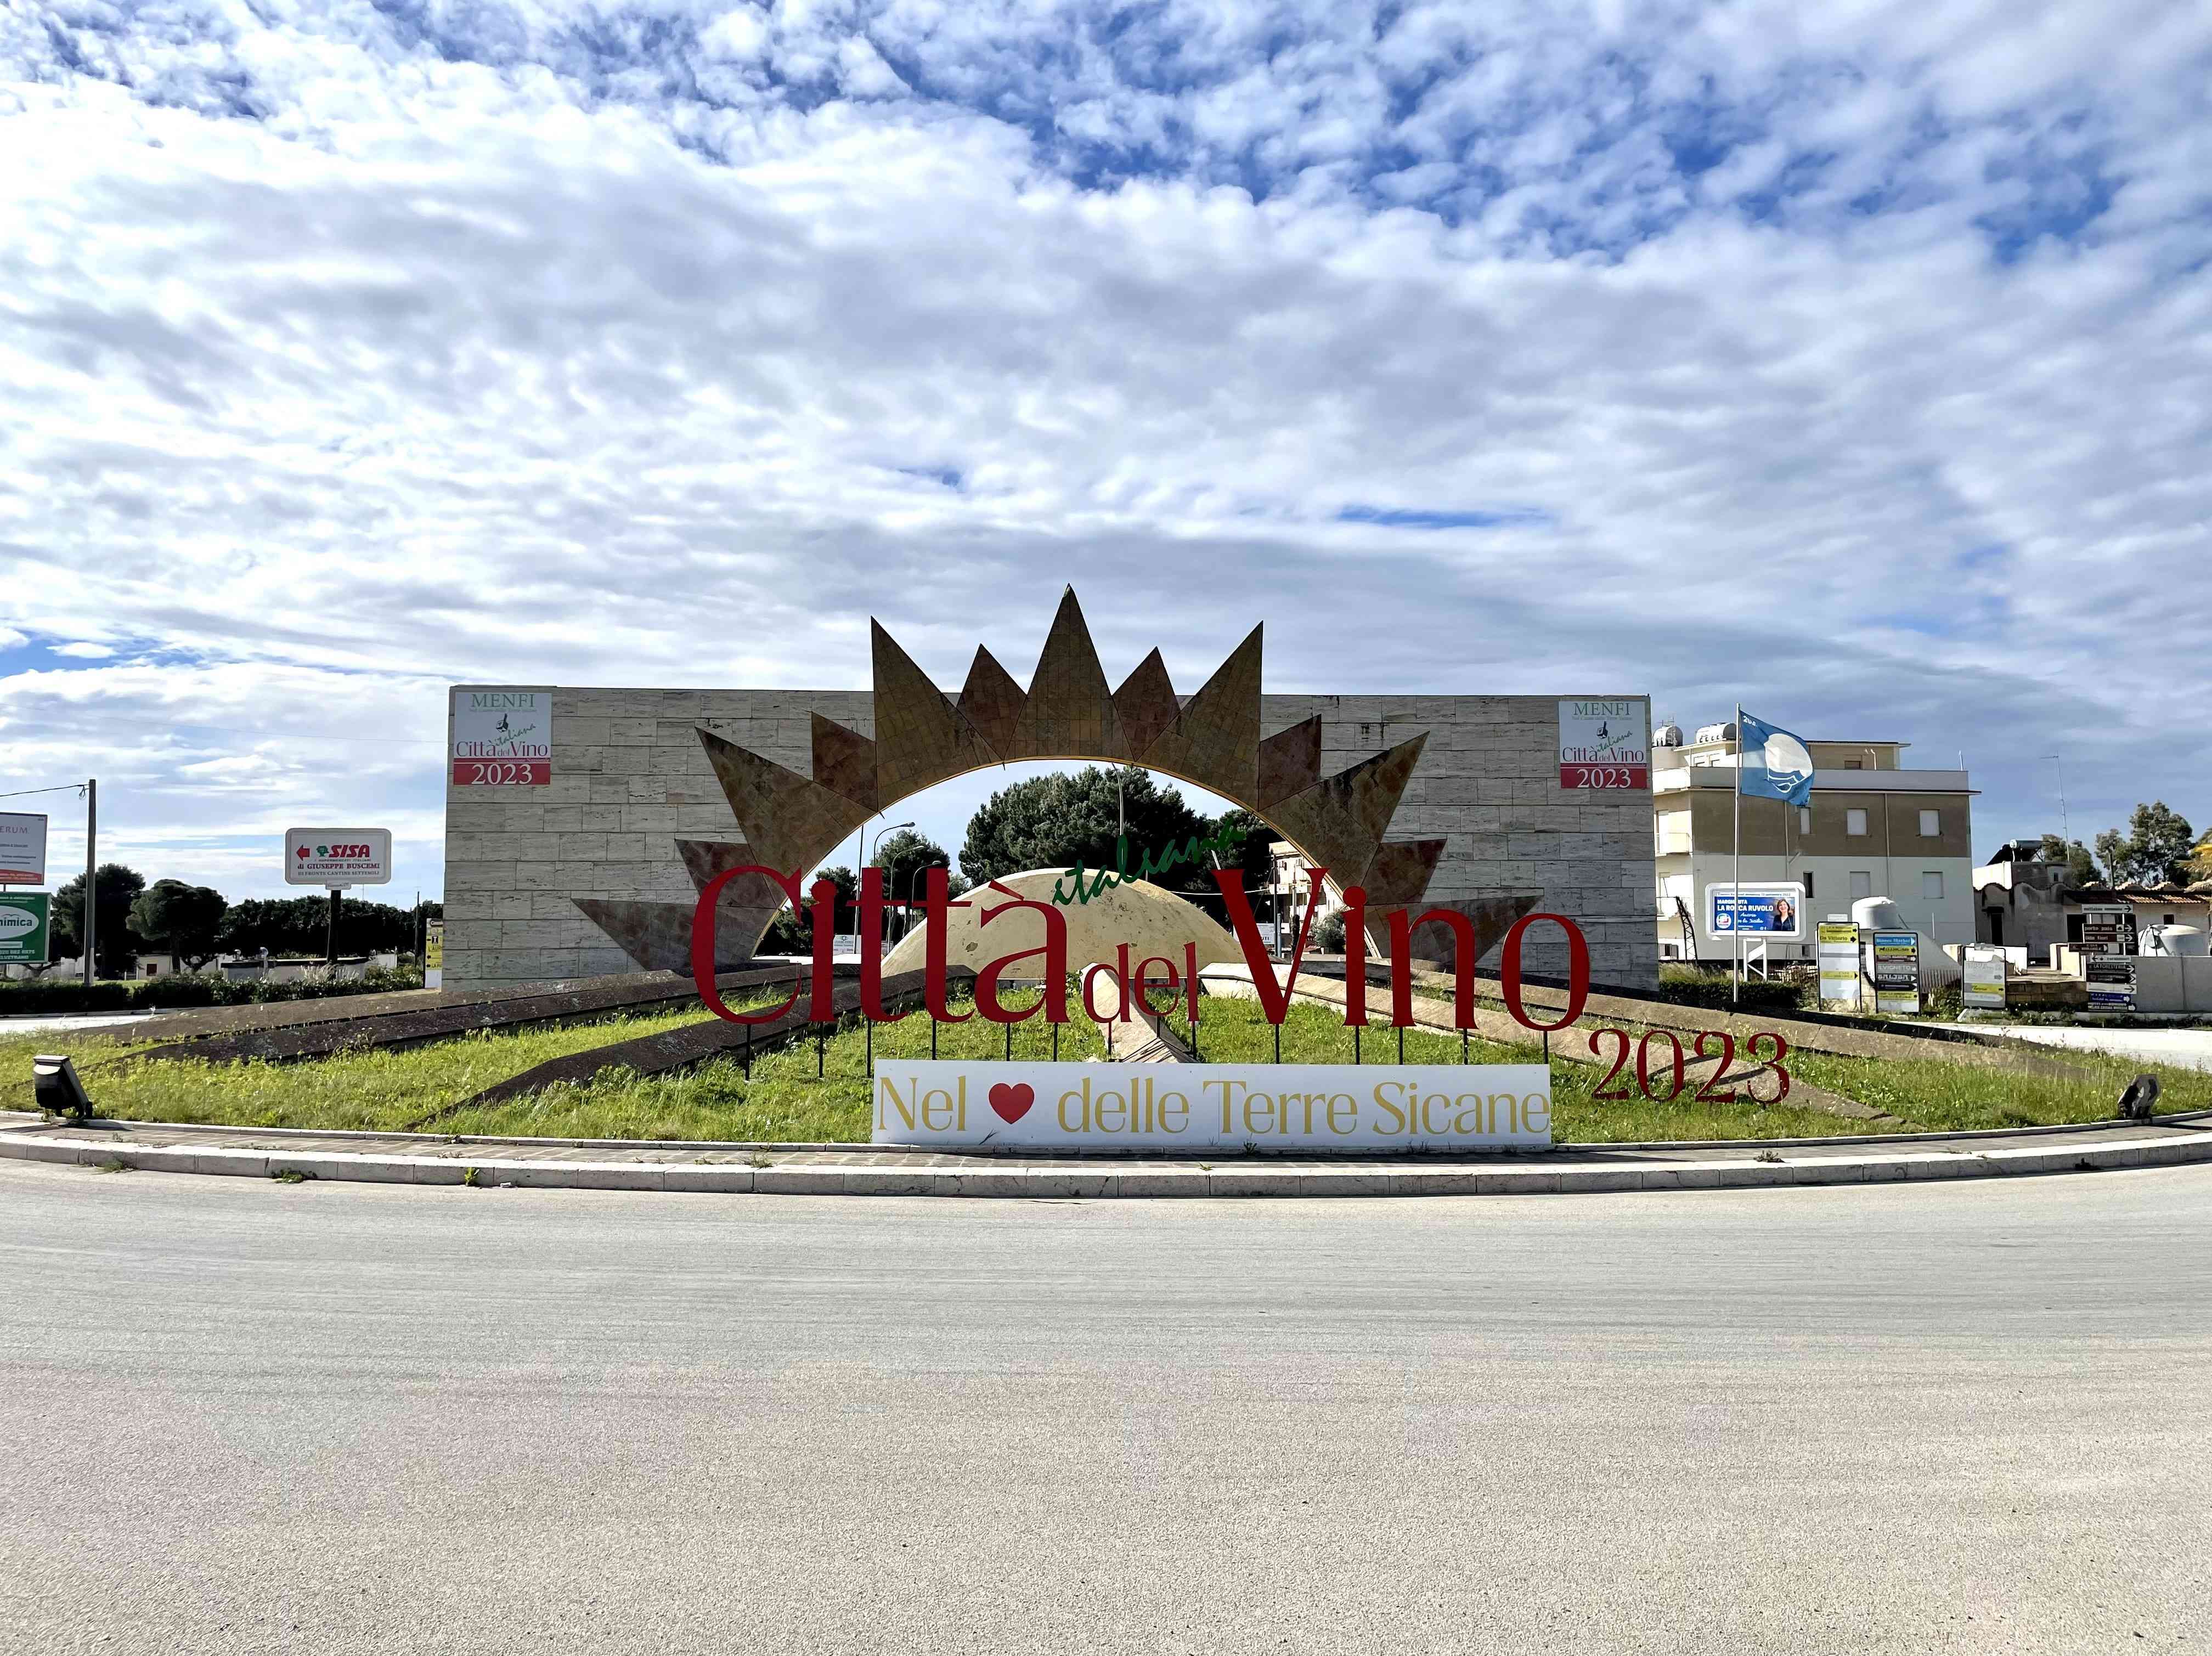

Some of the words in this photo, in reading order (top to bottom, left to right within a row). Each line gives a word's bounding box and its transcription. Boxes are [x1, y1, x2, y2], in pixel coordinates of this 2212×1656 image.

[472, 694, 535, 708] MENFI
[1573, 703, 1630, 716] MENFI
[456, 739, 496, 757] Città
[497, 748, 510, 756] del
[510, 741, 548, 757] Vino
[1597, 731, 1633, 752] italiana
[1562, 747, 1598, 762] Città
[1610, 747, 1644, 762] Vino
[471, 764, 533, 785] 2023
[1576, 768, 1632, 788] 2023
[329, 845, 370, 858] SISA
[1052, 816, 1246, 906] italiana
[692, 865, 1070, 1025] Città
[1084, 941, 1200, 1024] del
[1211, 868, 1589, 1031] Vino
[1588, 1028, 1790, 1105] 2023
[878, 1075, 966, 1132] Nel
[1058, 1076, 1189, 1134] delle
[1203, 1080, 1358, 1135] Terre
[1372, 1082, 1550, 1135] Sicane
